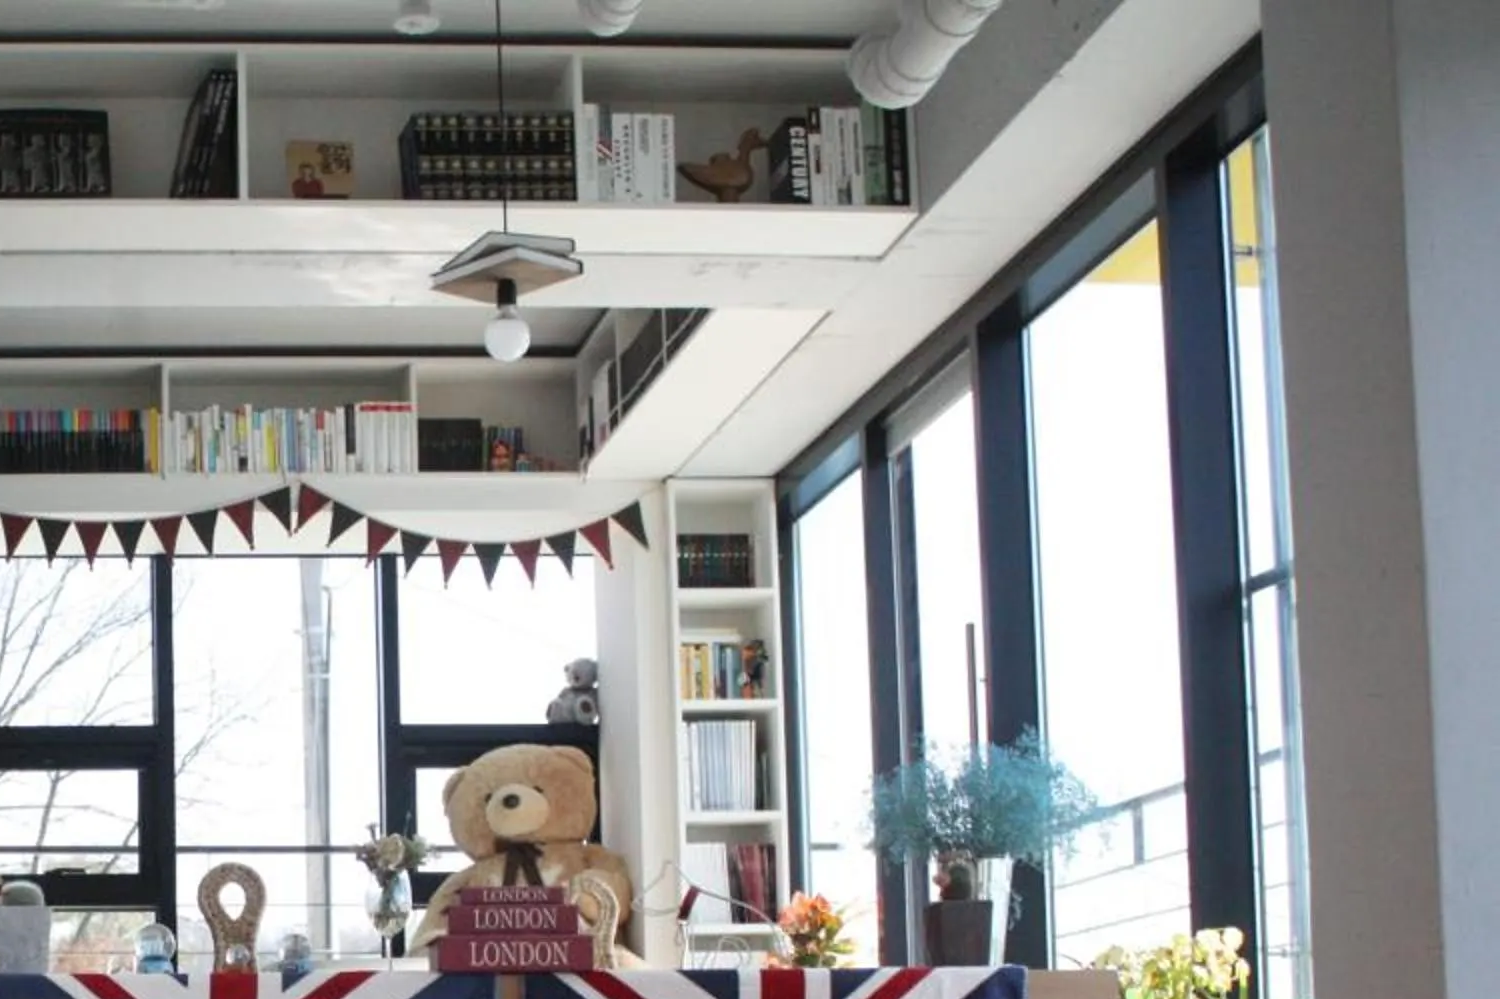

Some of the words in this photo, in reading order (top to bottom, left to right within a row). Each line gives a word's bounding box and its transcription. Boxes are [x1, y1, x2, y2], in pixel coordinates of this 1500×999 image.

[788, 126, 809, 199] CENTURY
[482, 888, 549, 902] LONDON
[473, 908, 558, 930] LONDON
[469, 940, 570, 967] LONDON
